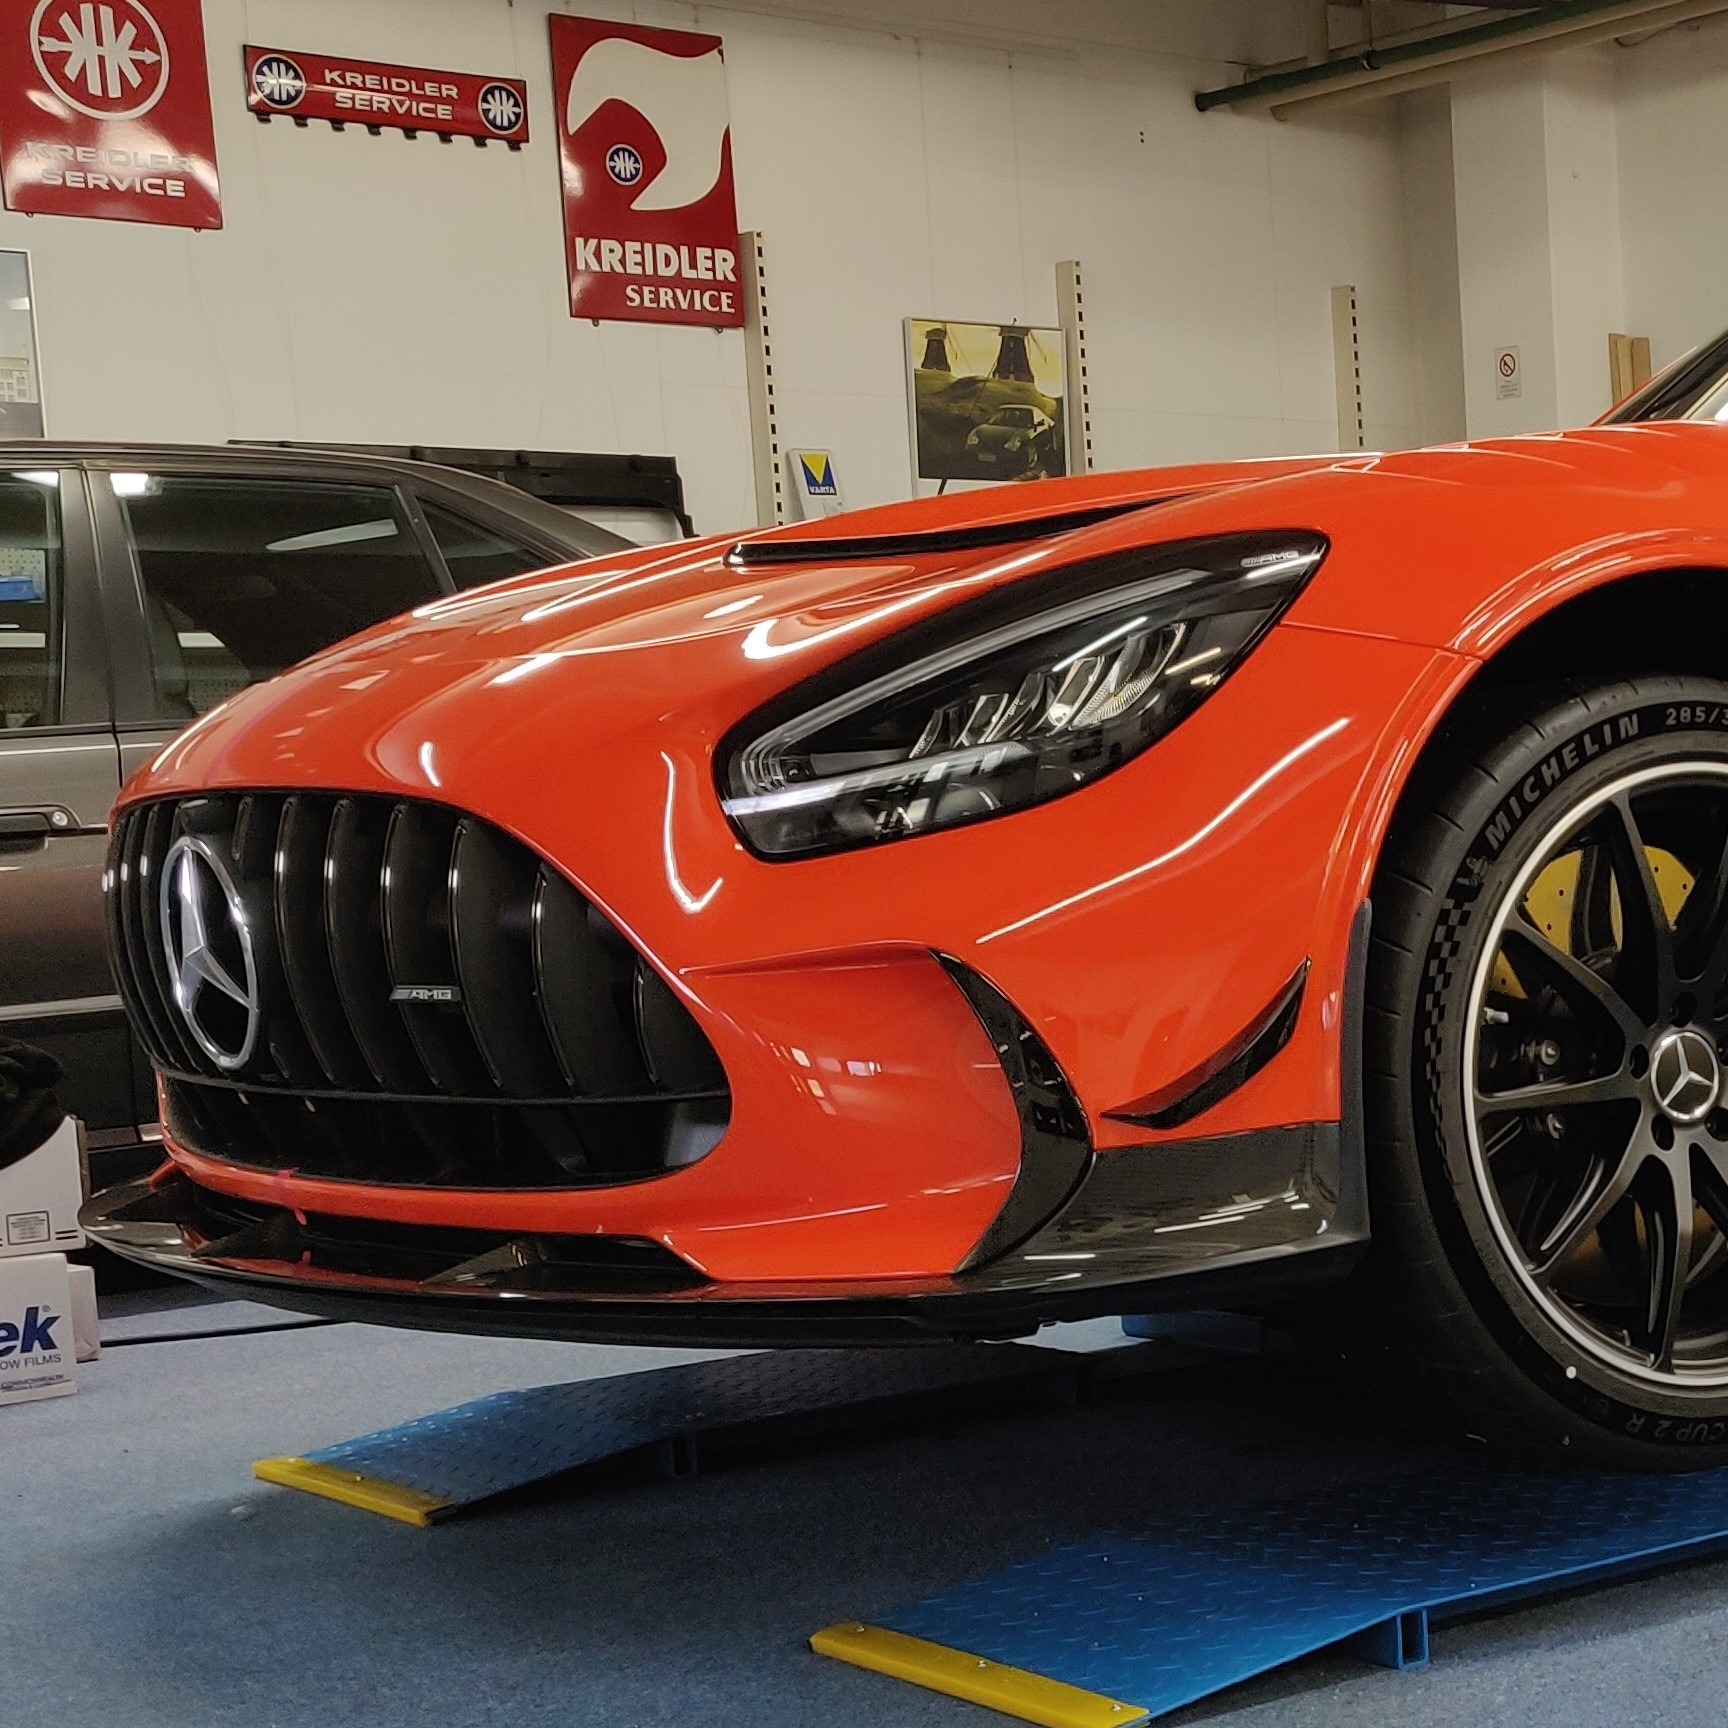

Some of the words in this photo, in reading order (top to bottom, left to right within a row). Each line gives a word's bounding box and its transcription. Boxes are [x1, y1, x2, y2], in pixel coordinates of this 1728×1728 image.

[324, 68, 459, 99] KREIDLER
[334, 91, 453, 119] SERVICE
[26, 141, 194, 170] KREIDLER
[41, 168, 186, 198] SERVICE
[574, 236, 737, 283] KREIDLER
[625, 284, 736, 313] SERVICE
[1484, 712, 1640, 851] MICHELIN
[24, 1353, 62, 1368] FILMS
[1674, 1420, 1726, 1442] CUP
